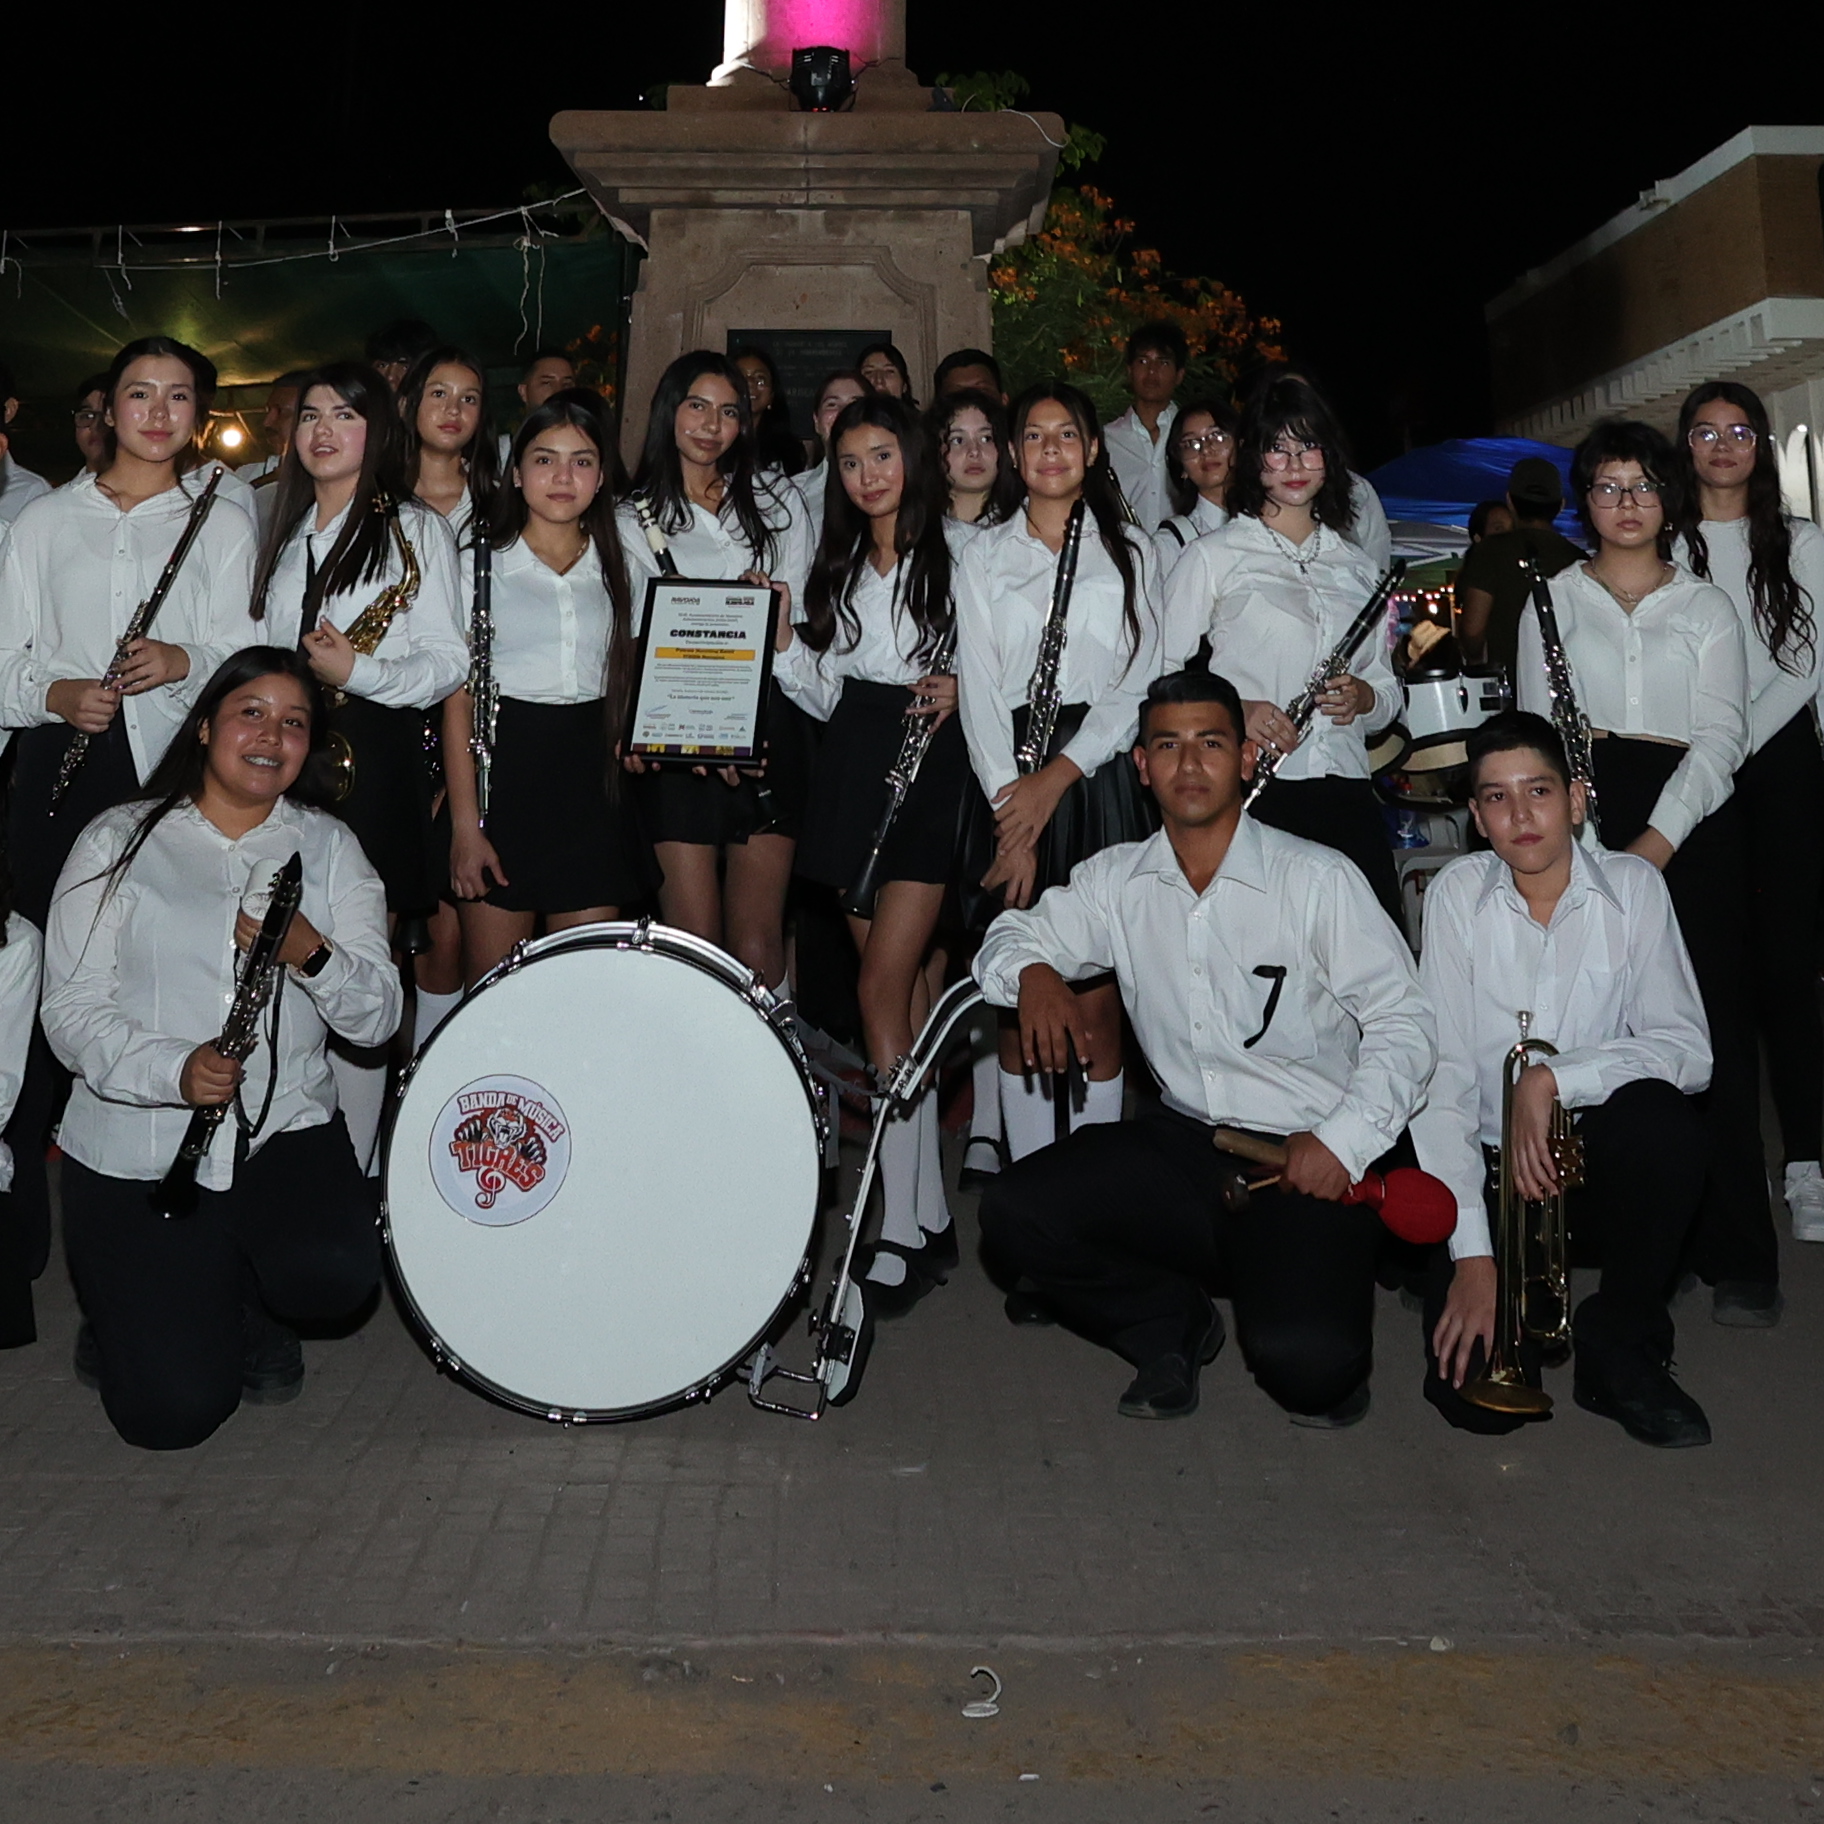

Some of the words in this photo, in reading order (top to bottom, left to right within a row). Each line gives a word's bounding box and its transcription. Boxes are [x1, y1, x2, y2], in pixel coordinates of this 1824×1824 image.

[670, 629, 746, 639] CONSTANCIA
[457, 1091, 507, 1114] BANDA
[506, 1093, 519, 1105] DE
[517, 1097, 565, 1143] MÚSICA
[449, 1140, 545, 1192] TIGRES
